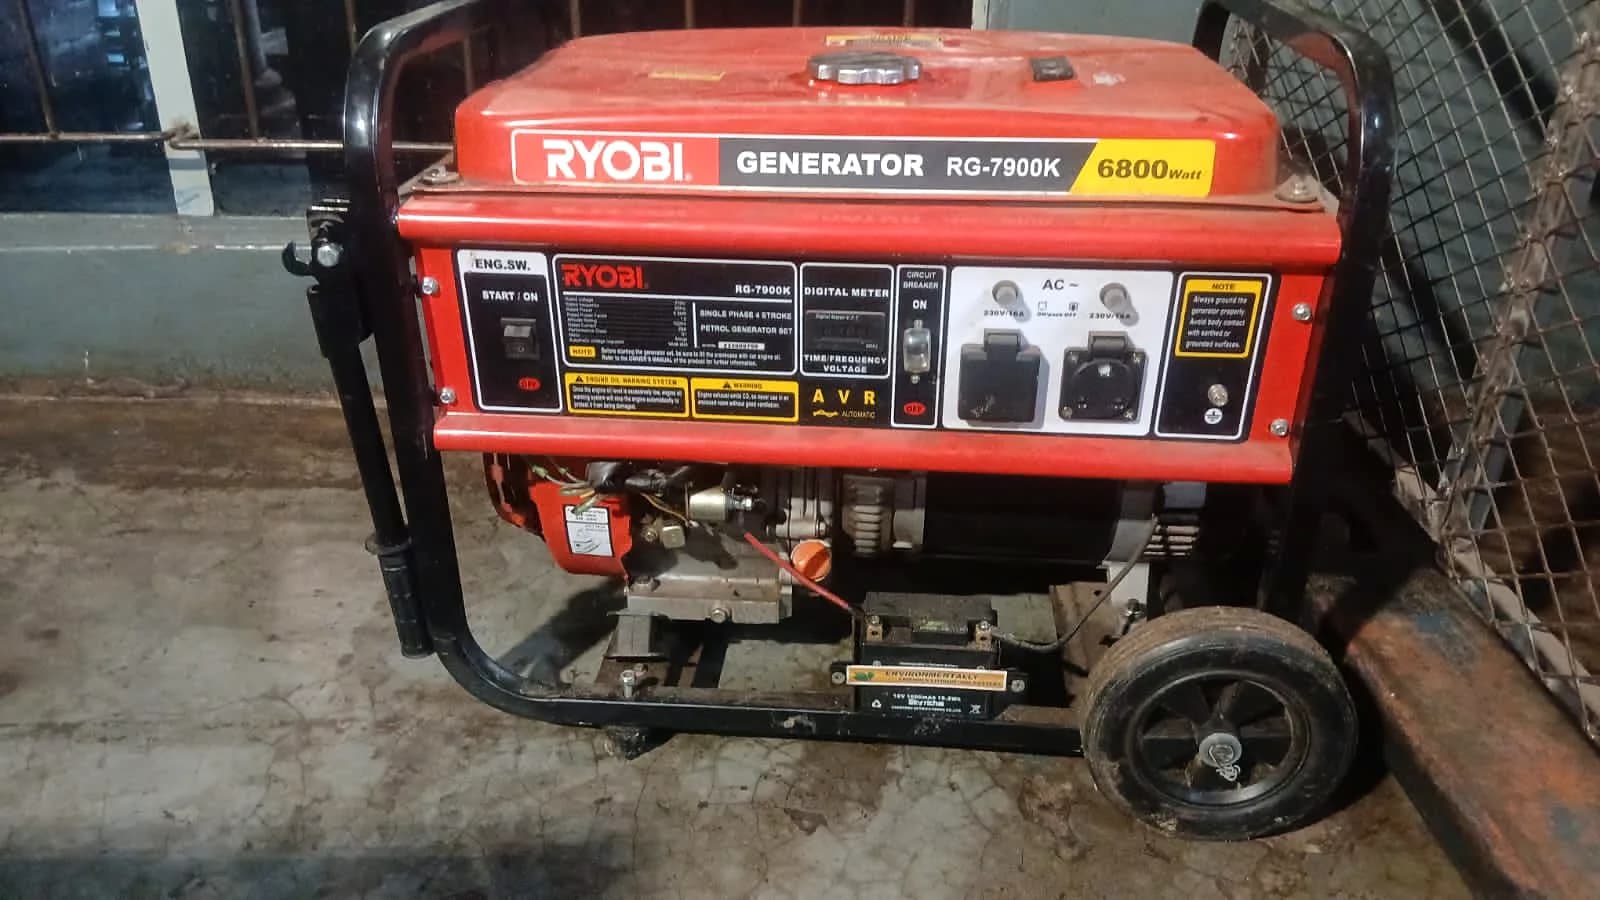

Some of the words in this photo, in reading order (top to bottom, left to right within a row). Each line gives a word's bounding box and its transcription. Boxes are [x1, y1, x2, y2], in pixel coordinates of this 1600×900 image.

[543, 138, 684, 182] RYOBI
[736, 150, 924, 177] GENERATOR
[946, 157, 1062, 179] RG-7900K
[475, 258, 531, 271] ENG.SW.
[561, 263, 645, 289] RYOBI
[906, 271, 936, 280] CIRCUIT
[735, 284, 791, 296] RG-7900K
[903, 281, 939, 290] BREAKER
[1042, 279, 1065, 291] AC
[482, 290, 514, 301] START
[524, 292, 538, 302] ON
[804, 286, 849, 297] DIGITAL
[852, 288, 889, 298] METER
[912, 300, 928, 310] ON
[1193, 296, 1215, 305] Always
[1215, 297, 1237, 305] ground
[700, 309, 727, 318] SINGLE
[728, 310, 754, 319] PHASE
[762, 312, 792, 320] STROKE
[1191, 308, 1220, 316] generator
[1190, 318, 1207, 326] Avoid
[1208, 320, 1223, 329] body
[700, 324, 730, 333] PETROL
[731, 325, 777, 335] GENERATOR
[778, 327, 793, 335] SET
[1186, 340, 1214, 349] grounded
[804, 353, 887, 364] TIME/FREQUENCY
[824, 364, 868, 374] VOLTAGE
[842, 410, 876, 419] AUTOMATIC
[885, 670, 977, 681] ENVIRONMENTALLY
